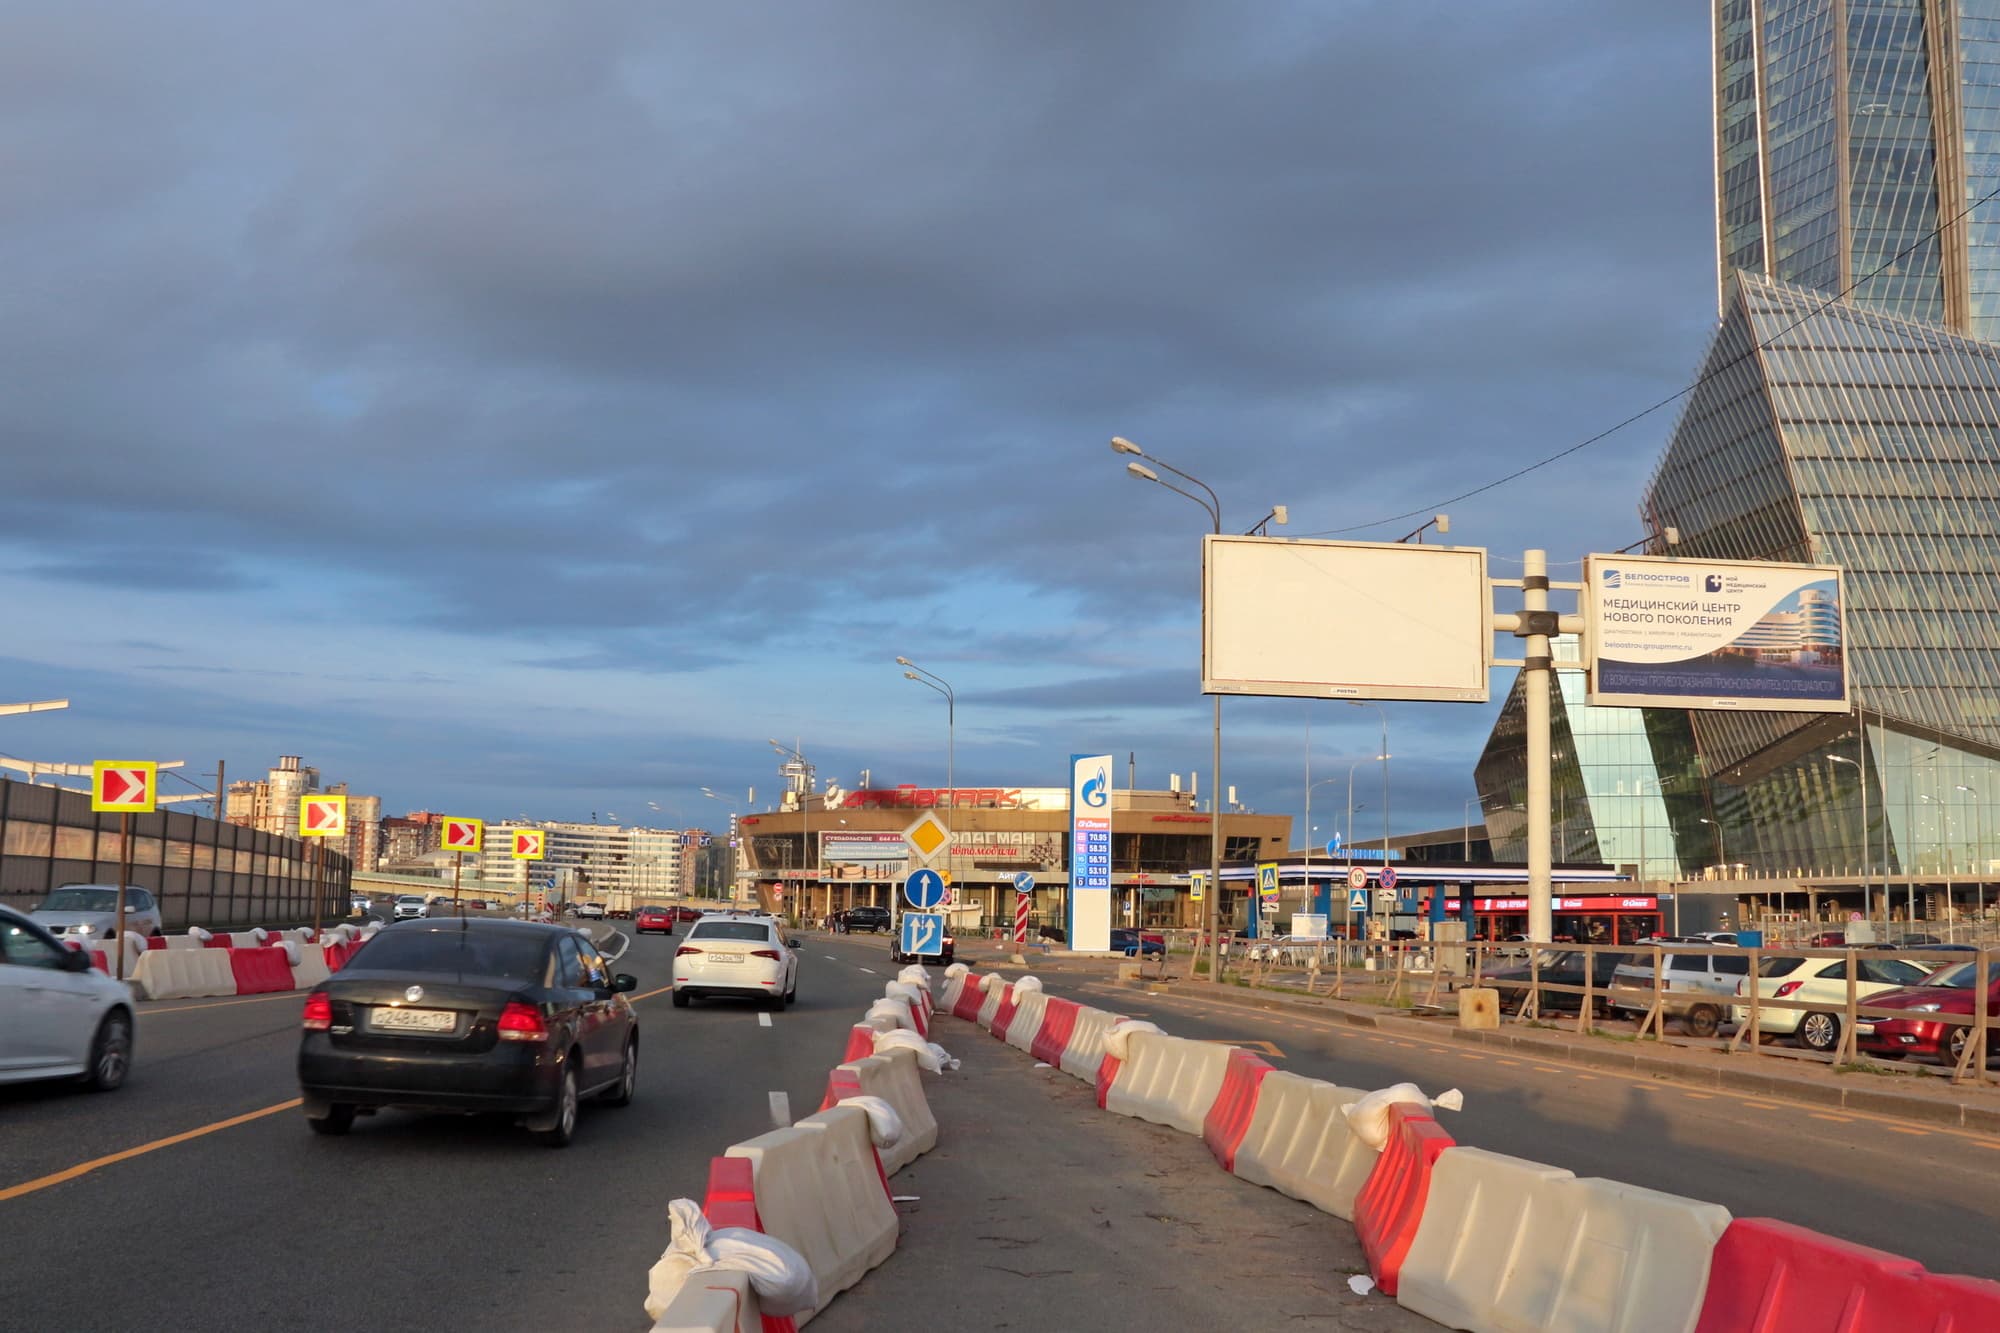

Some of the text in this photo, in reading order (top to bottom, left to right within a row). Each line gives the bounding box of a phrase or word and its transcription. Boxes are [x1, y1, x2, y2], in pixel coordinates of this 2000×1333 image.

[1625, 573, 1690, 582] БЕЛООСТРОВ
[1603, 598, 1741, 613] МЕДИЦИНСКИЙ ЦЕНТР
[1603, 612, 1732, 626] НОВОГО ПОКОЛЕНИЯ
[1089, 867, 1106, 875] 53.10
[1354, 873, 1362, 882] 10
